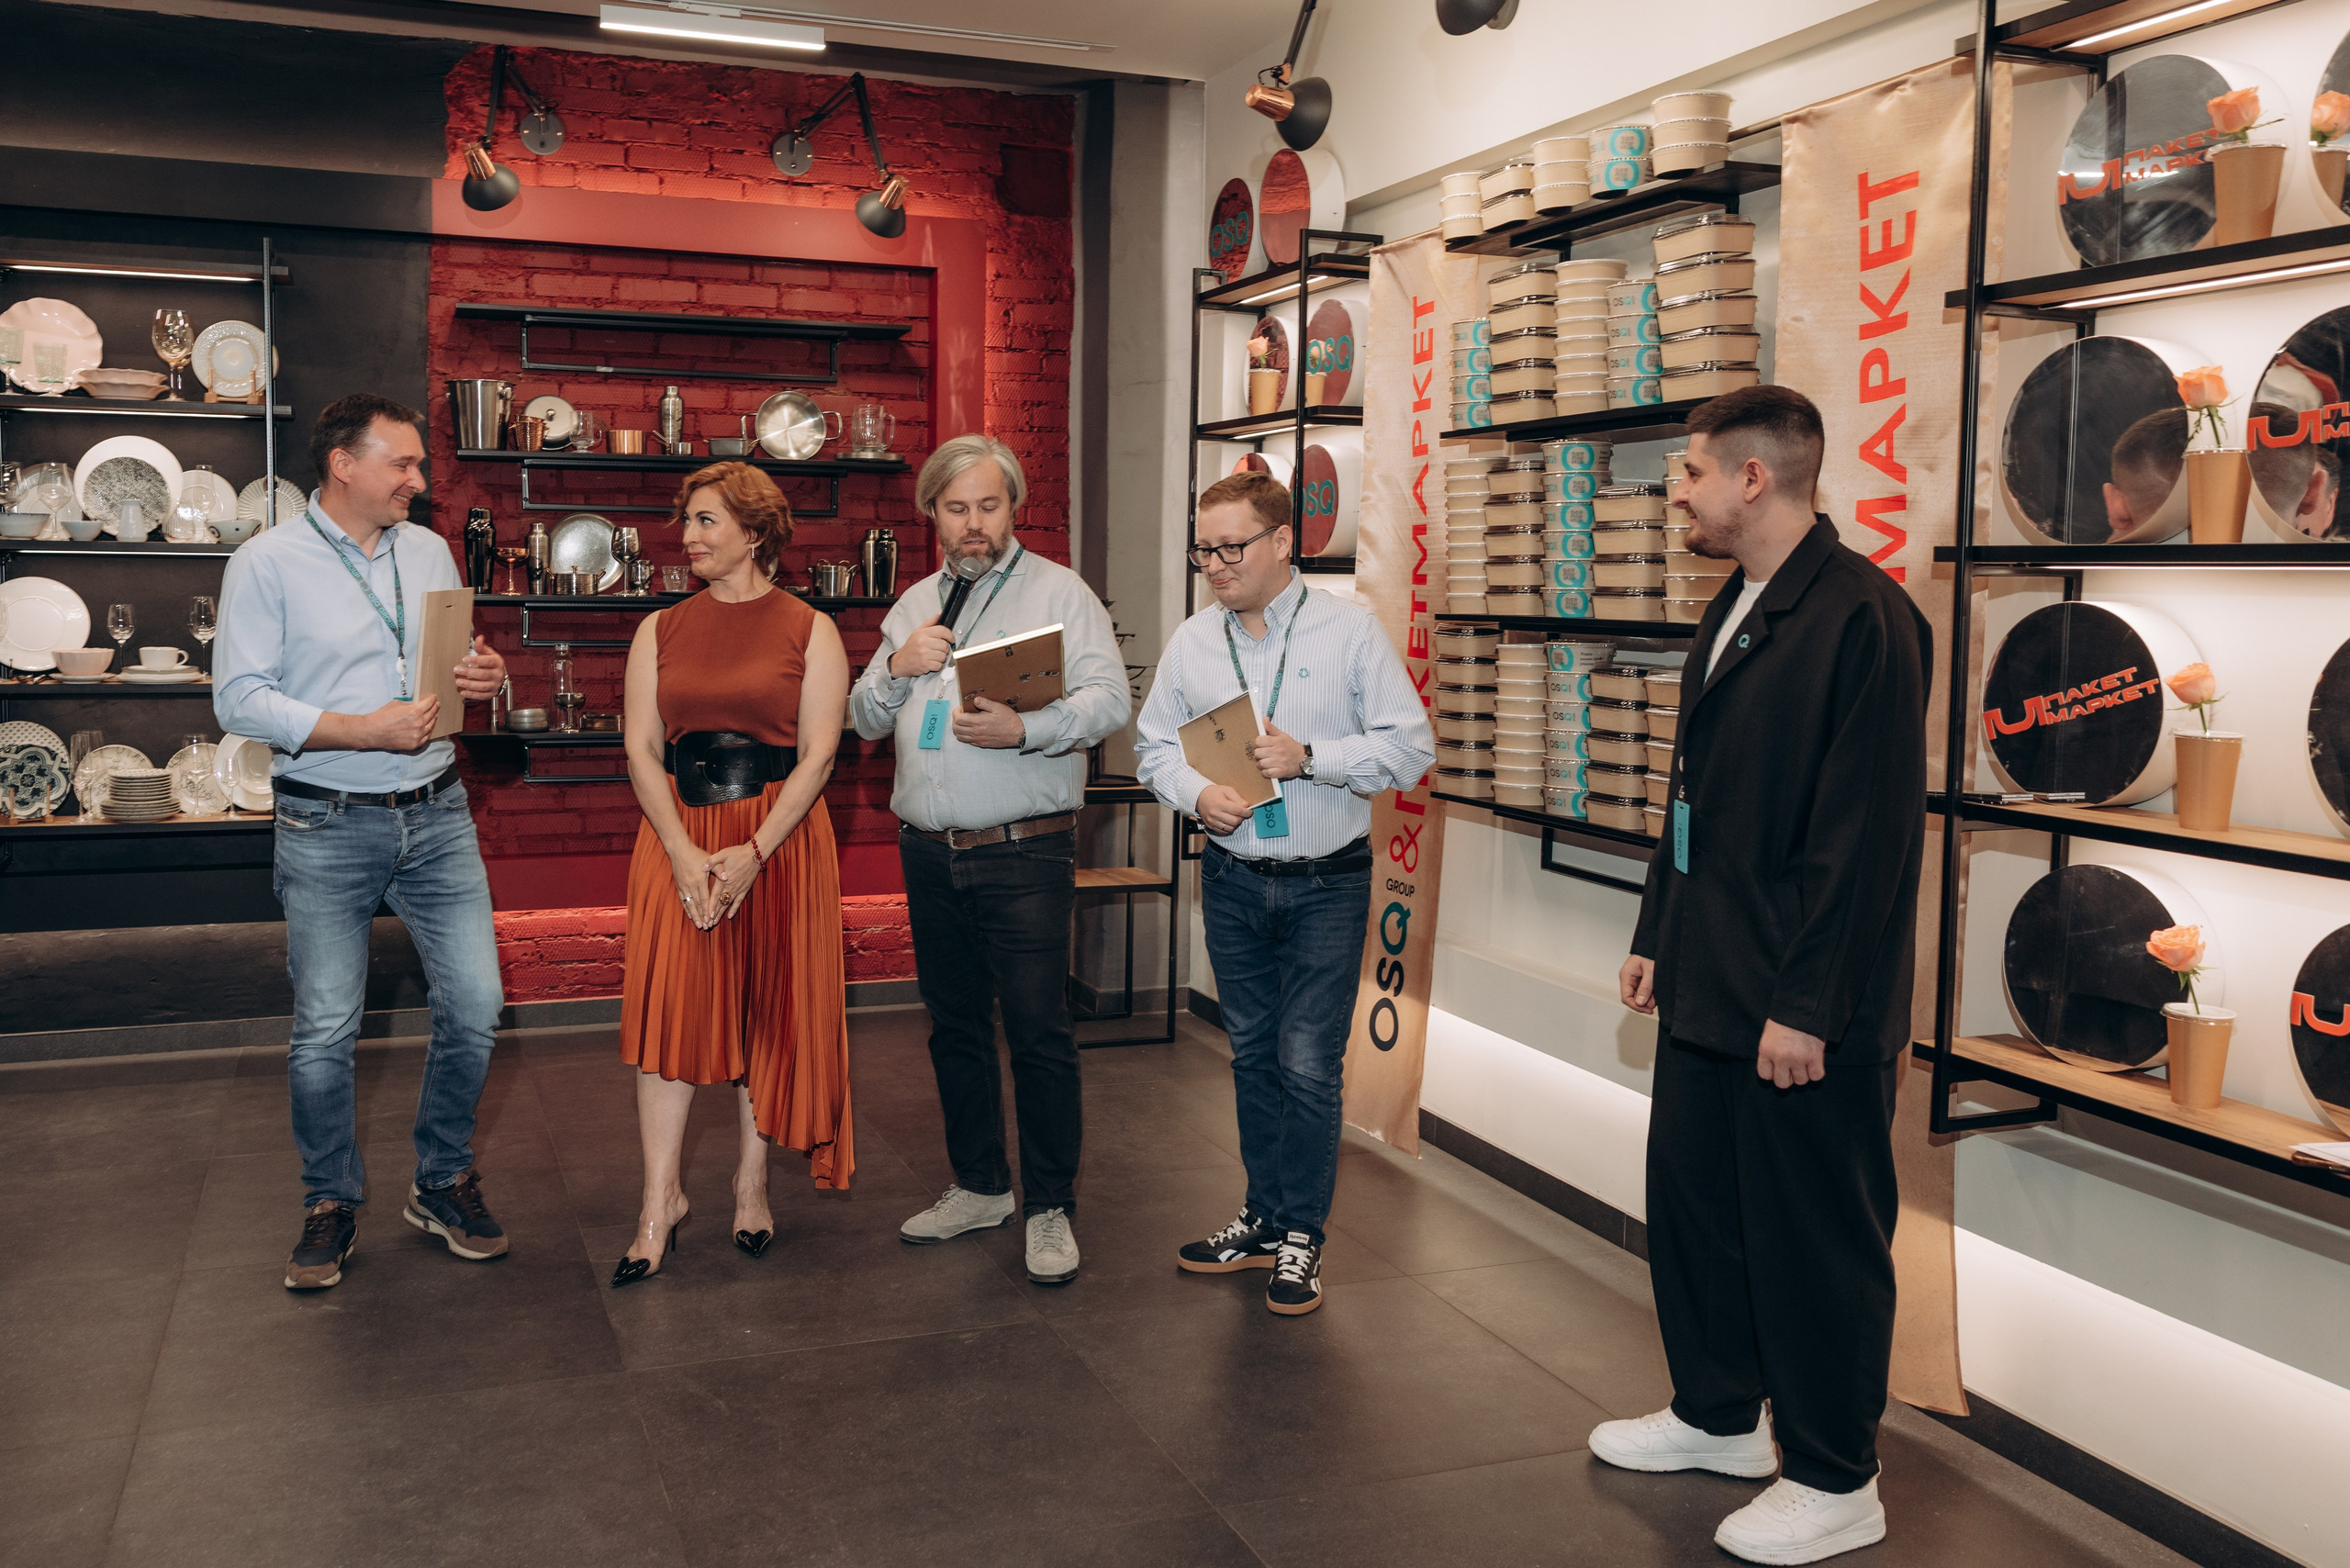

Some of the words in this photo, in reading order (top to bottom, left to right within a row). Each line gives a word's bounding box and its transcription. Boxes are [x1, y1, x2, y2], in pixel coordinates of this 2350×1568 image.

[2125, 148, 2210, 185] МАРК
[1210, 211, 1249, 257] OSQ
[1306, 335, 1352, 375] OSQ
[1394, 296, 1435, 816] ПКЕТМАРКЕТ
[378, 607, 395, 630] GROUP
[1550, 683, 1569, 692] OSQ
[2042, 666, 2137, 709] ПАКЕТ
[1269, 689, 1279, 714] GROUP
[2046, 678, 2159, 725] МАРКЕТ
[926, 717, 937, 740] OSQ
[1552, 711, 1572, 722] OSQ
[1549, 740, 1567, 750] OSQ
[1550, 768, 1568, 778] OSQ
[1546, 797, 1563, 807] OSQ
[1386, 878, 1415, 897] GROUP
[1369, 902, 1412, 1052] OSQ
